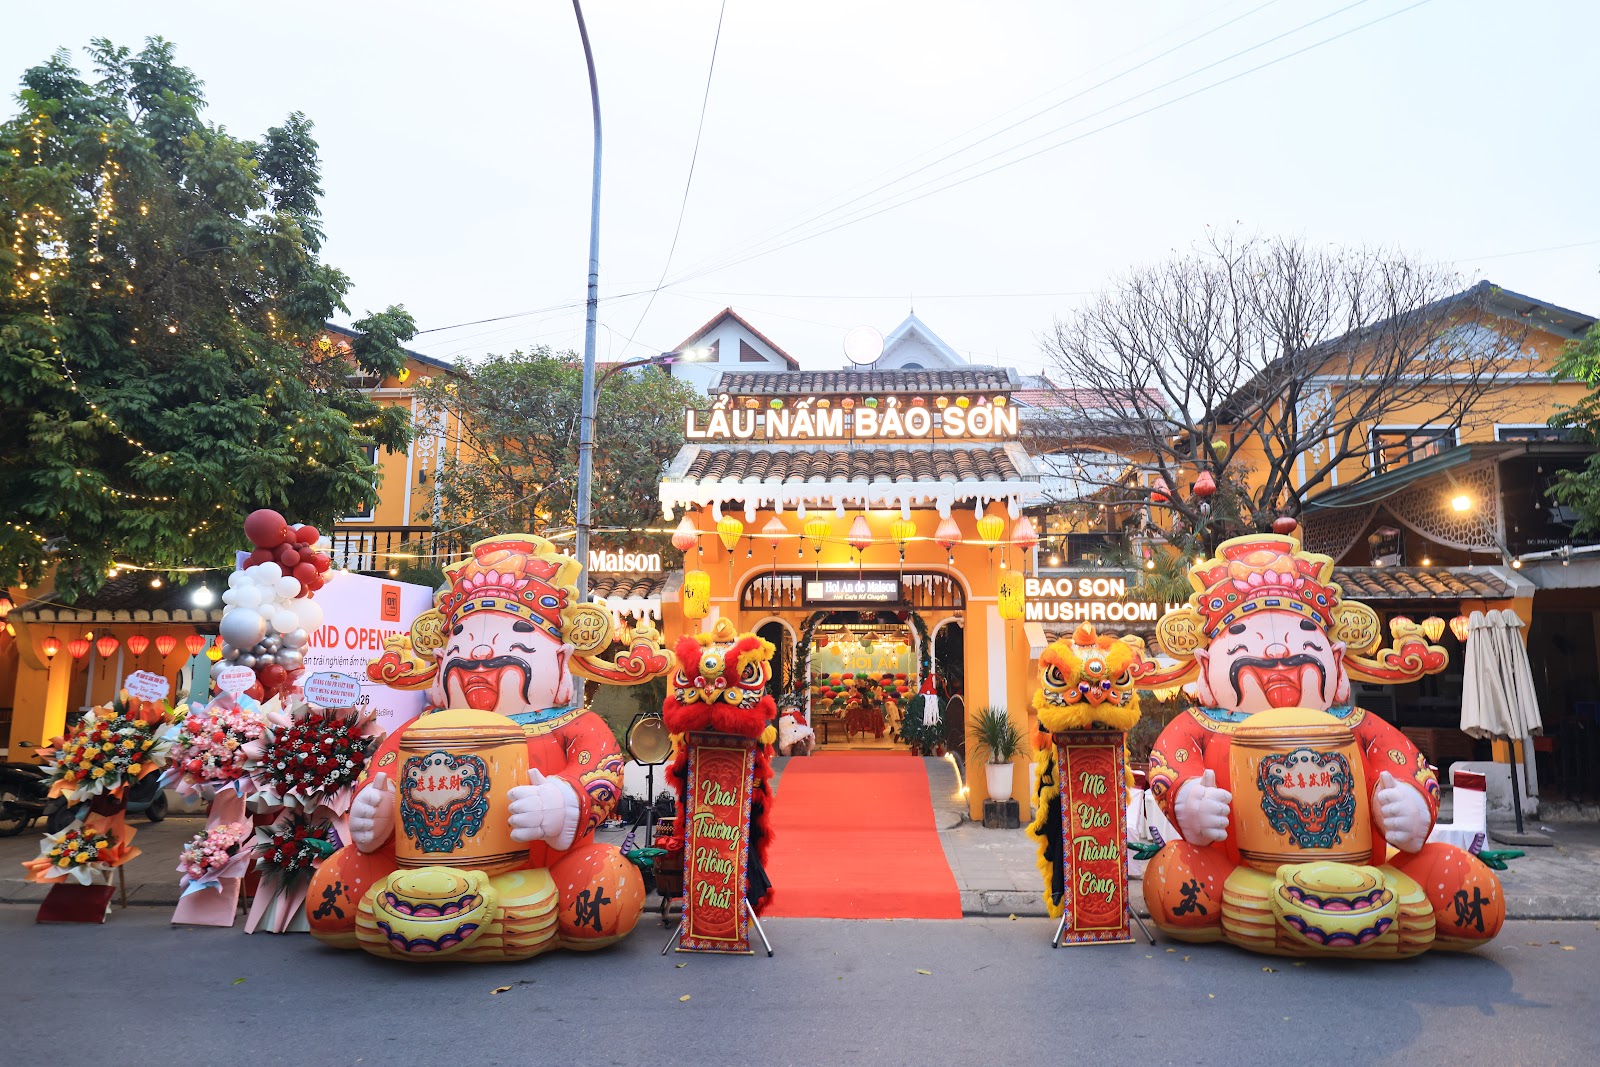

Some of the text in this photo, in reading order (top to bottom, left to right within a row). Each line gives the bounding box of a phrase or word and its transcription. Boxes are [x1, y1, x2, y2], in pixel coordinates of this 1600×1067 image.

[686, 394, 1018, 438] LẨU NẤM BẢO SƠN
[588, 548, 661, 572] Maison
[1025, 578, 1125, 597] BAO SON
[1025, 602, 1158, 621] MUSHROOM
[701, 779, 737, 807] Khai
[1079, 771, 1108, 799] Mã
[1077, 803, 1112, 829] Đáo
[692, 812, 742, 850] Trương
[1073, 835, 1120, 862] Thành
[695, 846, 735, 885] Hồng
[696, 880, 735, 910] Phát
[1078, 867, 1117, 903] Công
[573, 886, 611, 932] 财
[1453, 886, 1490, 932] 财
